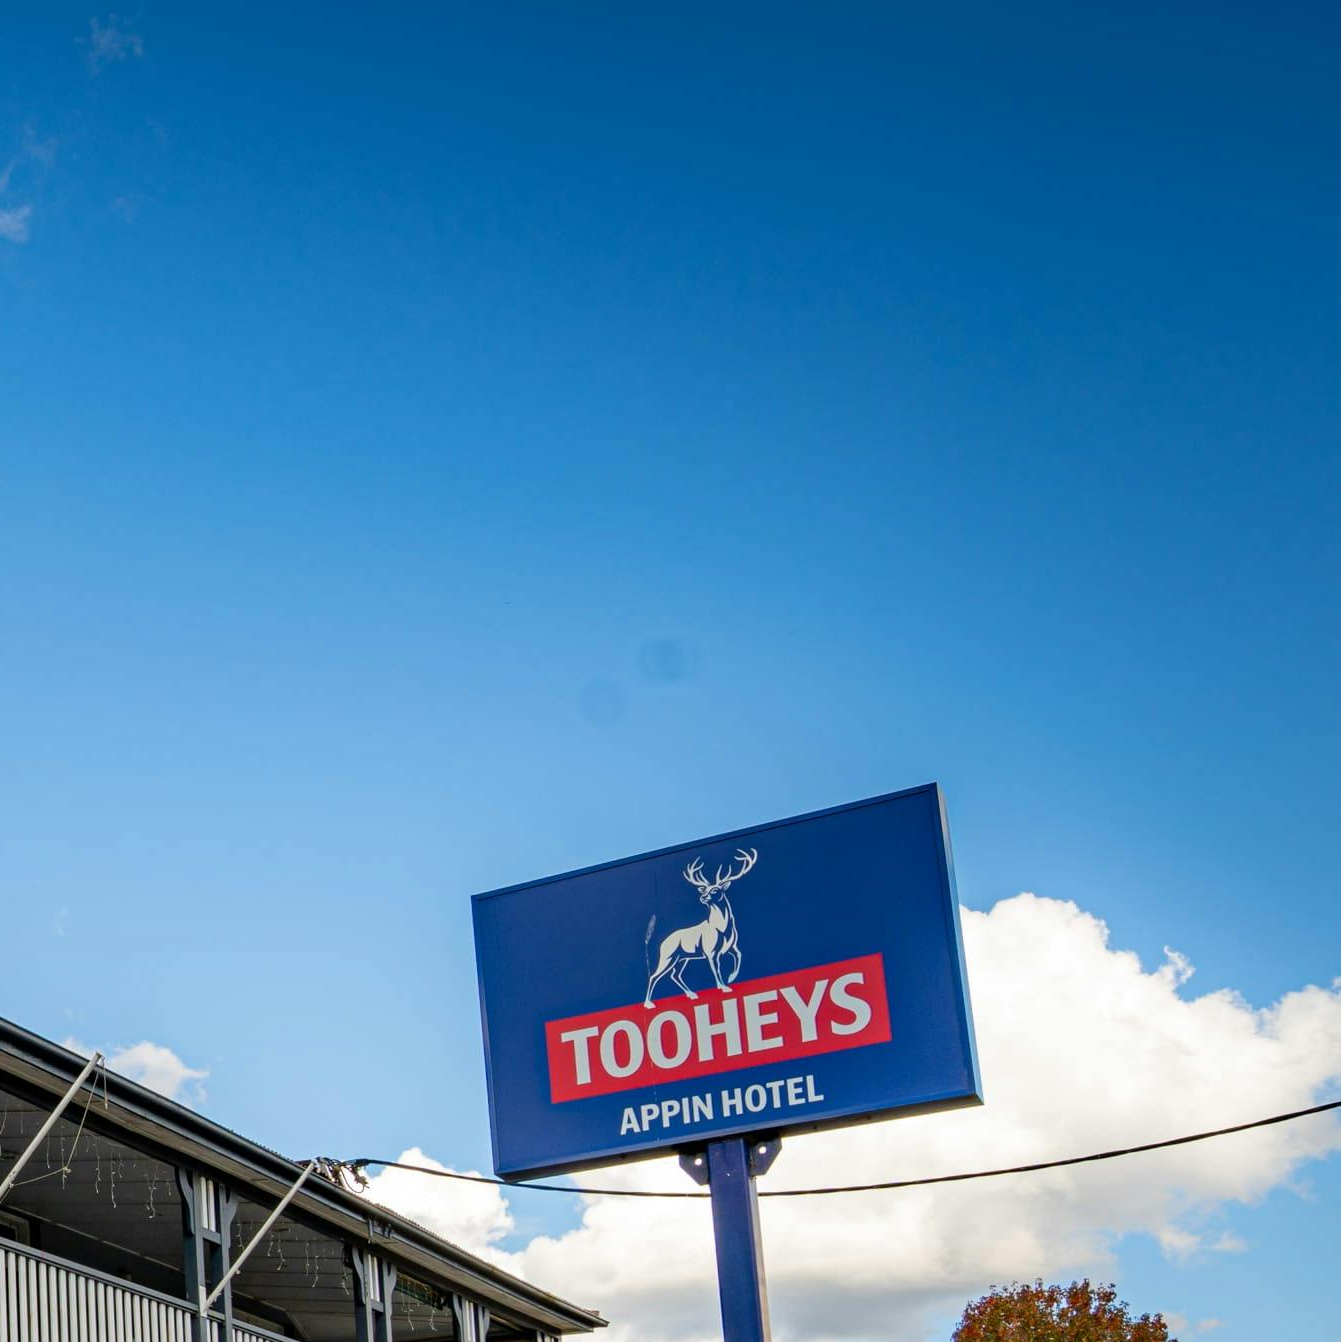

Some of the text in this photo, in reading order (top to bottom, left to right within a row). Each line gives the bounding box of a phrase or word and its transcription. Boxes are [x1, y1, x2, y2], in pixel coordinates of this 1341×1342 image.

[560, 972, 873, 1086] TOOHEYS
[620, 1074, 824, 1136] APPIN HOTEL
